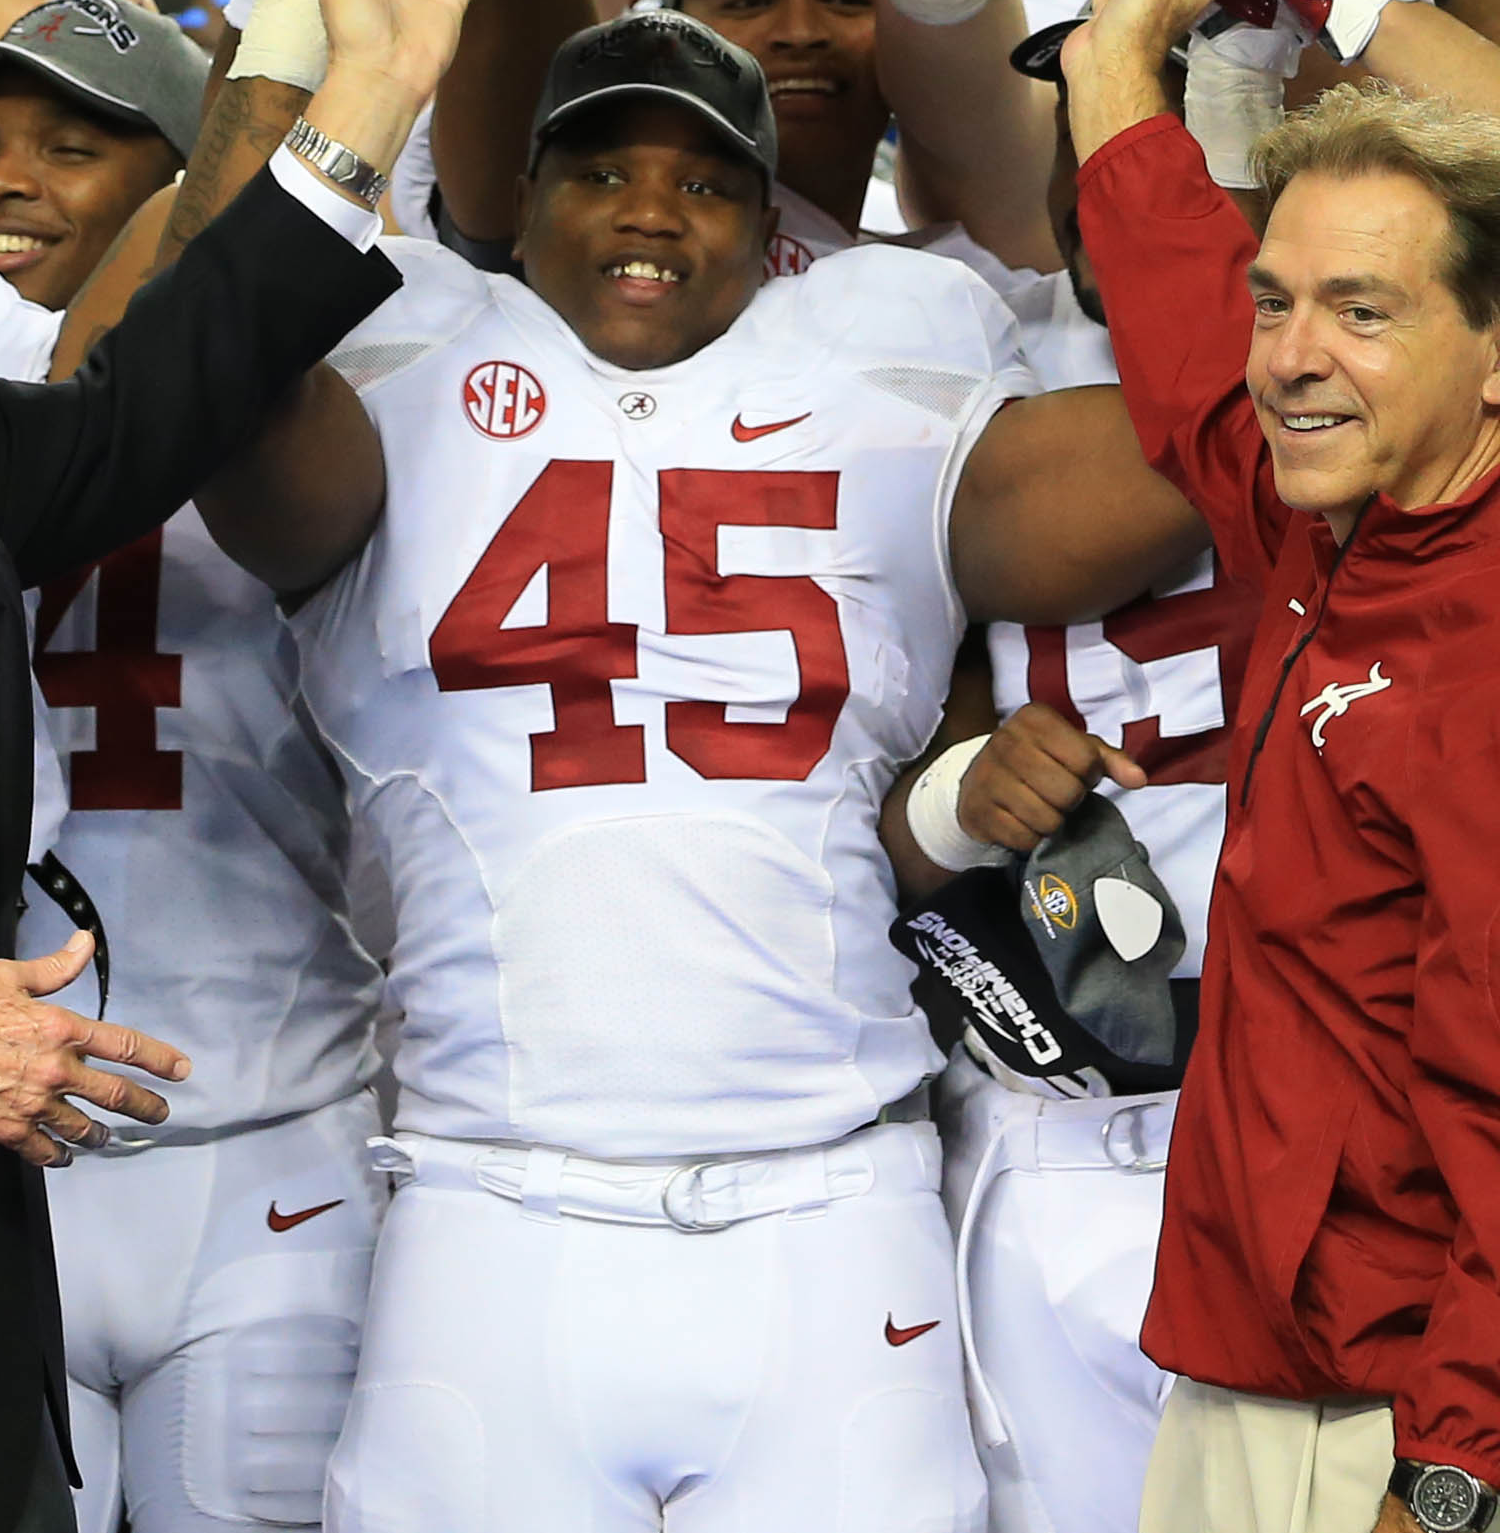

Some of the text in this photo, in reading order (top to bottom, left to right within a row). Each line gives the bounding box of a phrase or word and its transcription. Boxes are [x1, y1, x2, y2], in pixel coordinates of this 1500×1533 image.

[467, 362, 543, 437] SEC
[428, 459, 850, 793] 45
[906, 911, 1062, 1066] CHAMPIONS
